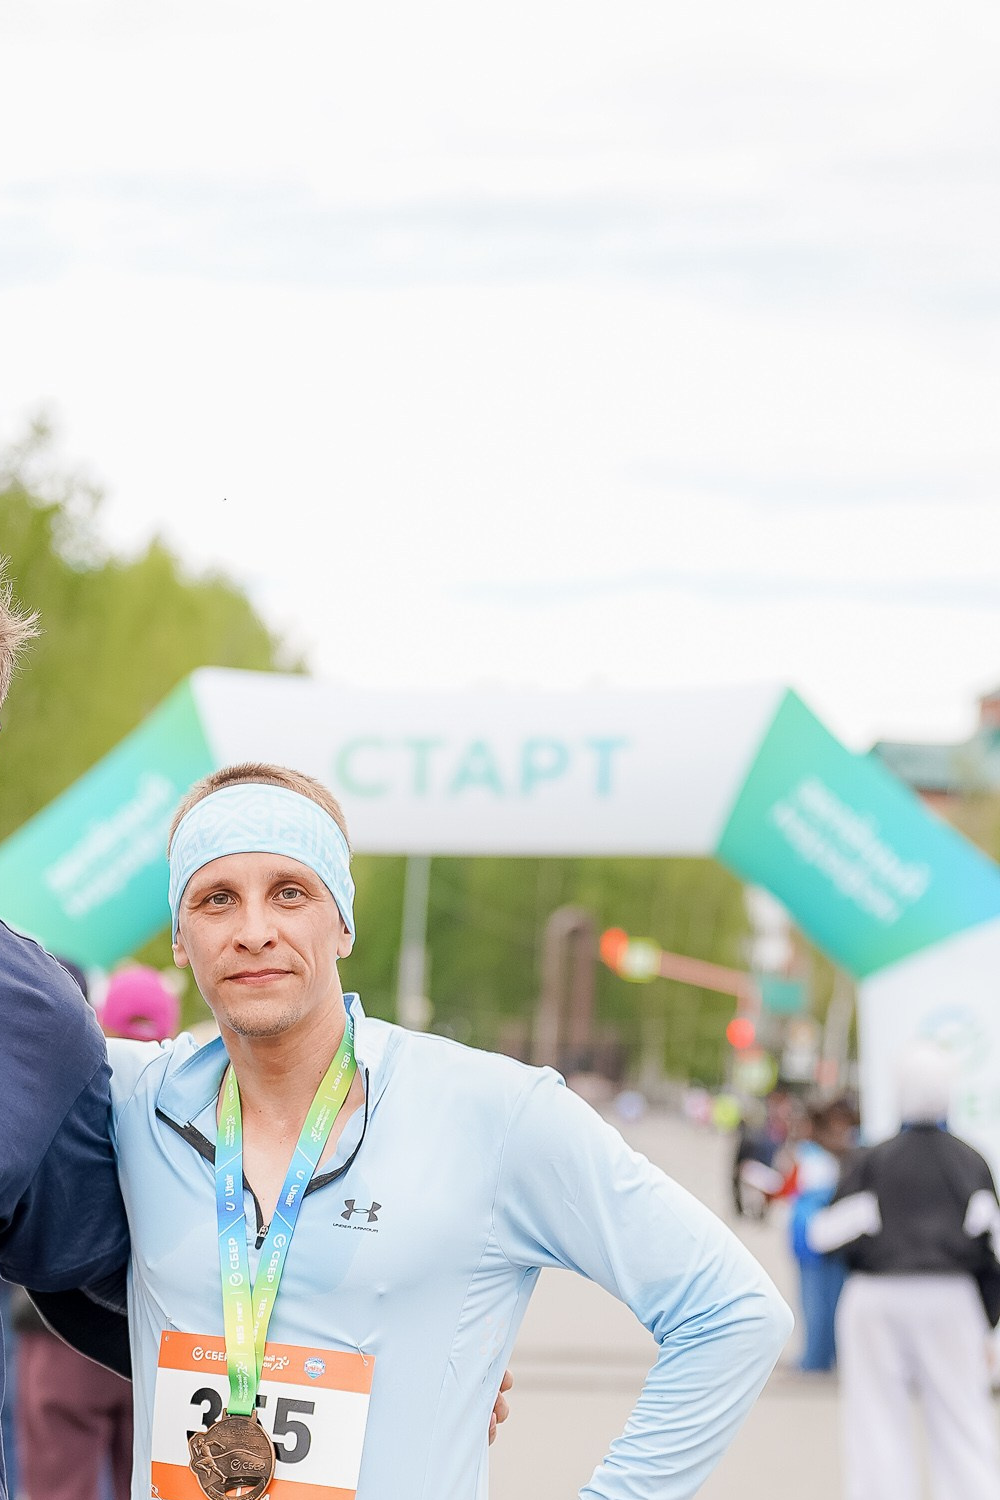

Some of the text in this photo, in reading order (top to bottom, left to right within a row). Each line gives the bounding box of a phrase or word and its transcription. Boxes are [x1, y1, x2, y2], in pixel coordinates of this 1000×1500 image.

[334, 737, 630, 799] СТАРТ
[225, 1174, 235, 1197] Utair
[284, 1184, 300, 1208] Utair
[228, 1237, 240, 1270] СБЕР
[266, 1251, 281, 1284] СБЕР
[187, 1387, 316, 1464] 35
